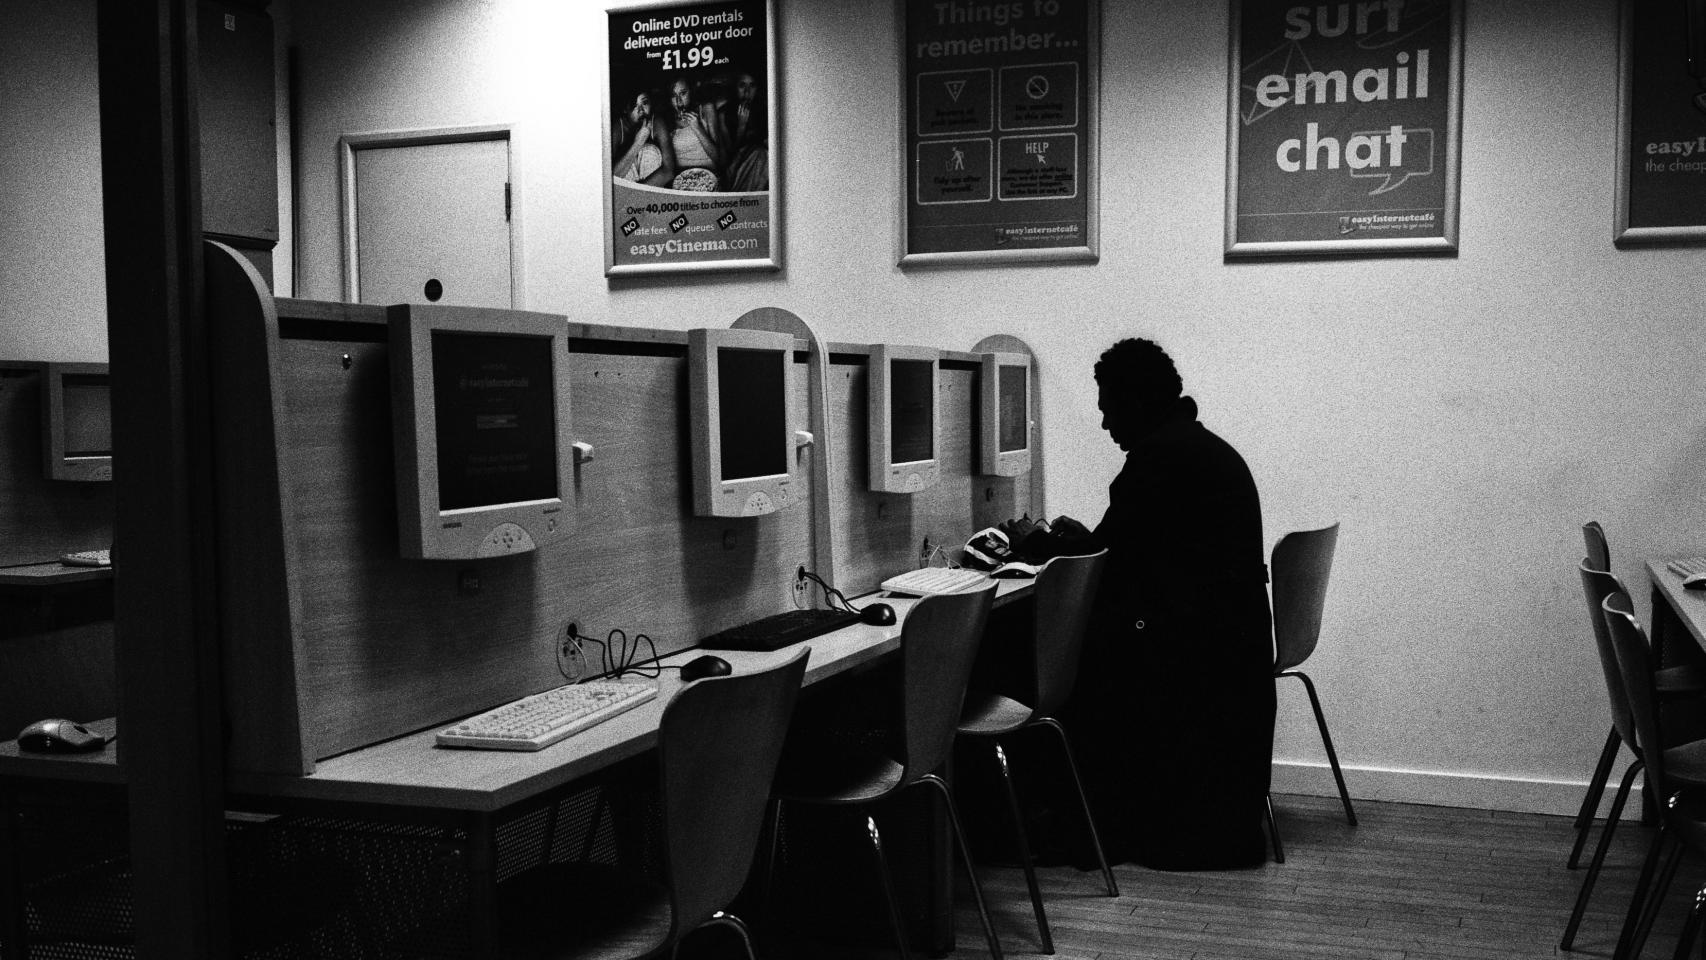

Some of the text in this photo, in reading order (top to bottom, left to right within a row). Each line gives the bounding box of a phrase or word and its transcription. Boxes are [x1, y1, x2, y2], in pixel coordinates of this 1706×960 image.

[632, 9, 744, 33] Online DVD rentals
[934, 1, 1025, 26] Things
[624, 26, 753, 50] delivered to your door
[916, 26, 1079, 58] remember...
[662, 46, 714, 70] £1.99
[714, 56, 730, 64] each
[1256, 49, 1430, 107] email
[1025, 142, 1049, 154] HELP
[1276, 122, 1407, 173] chat
[626, 198, 760, 216] Over 40,000 titles to choose from
[623, 220, 637, 234] NO
[651, 225, 668, 235] fees
[672, 216, 715, 234] NO queues
[720, 214, 768, 230] NO contracts
[1351, 212, 1436, 224] easyInternetcafé
[630, 238, 758, 257] easyCinema.com
